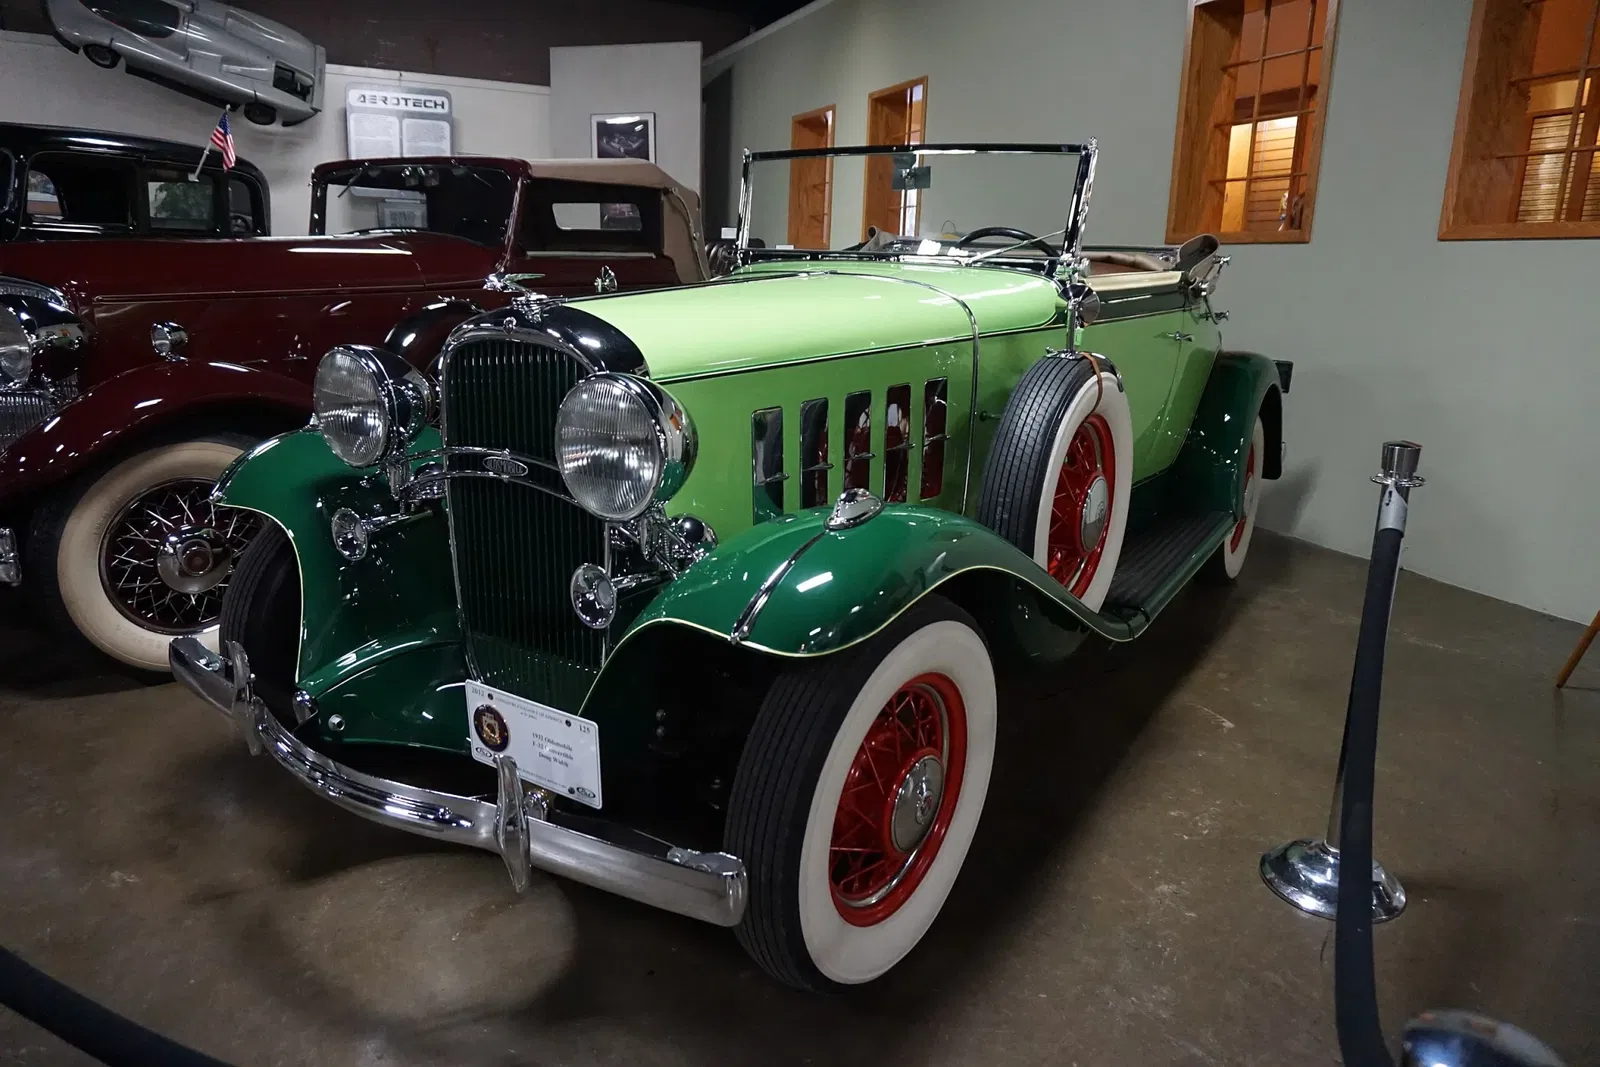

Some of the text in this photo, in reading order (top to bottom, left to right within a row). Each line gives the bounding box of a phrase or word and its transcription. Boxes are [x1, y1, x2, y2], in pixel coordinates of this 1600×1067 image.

[358, 94, 445, 109] AEROTECH
[471, 687, 485, 697] 2012
[544, 744, 574, 760] Cnvertible
